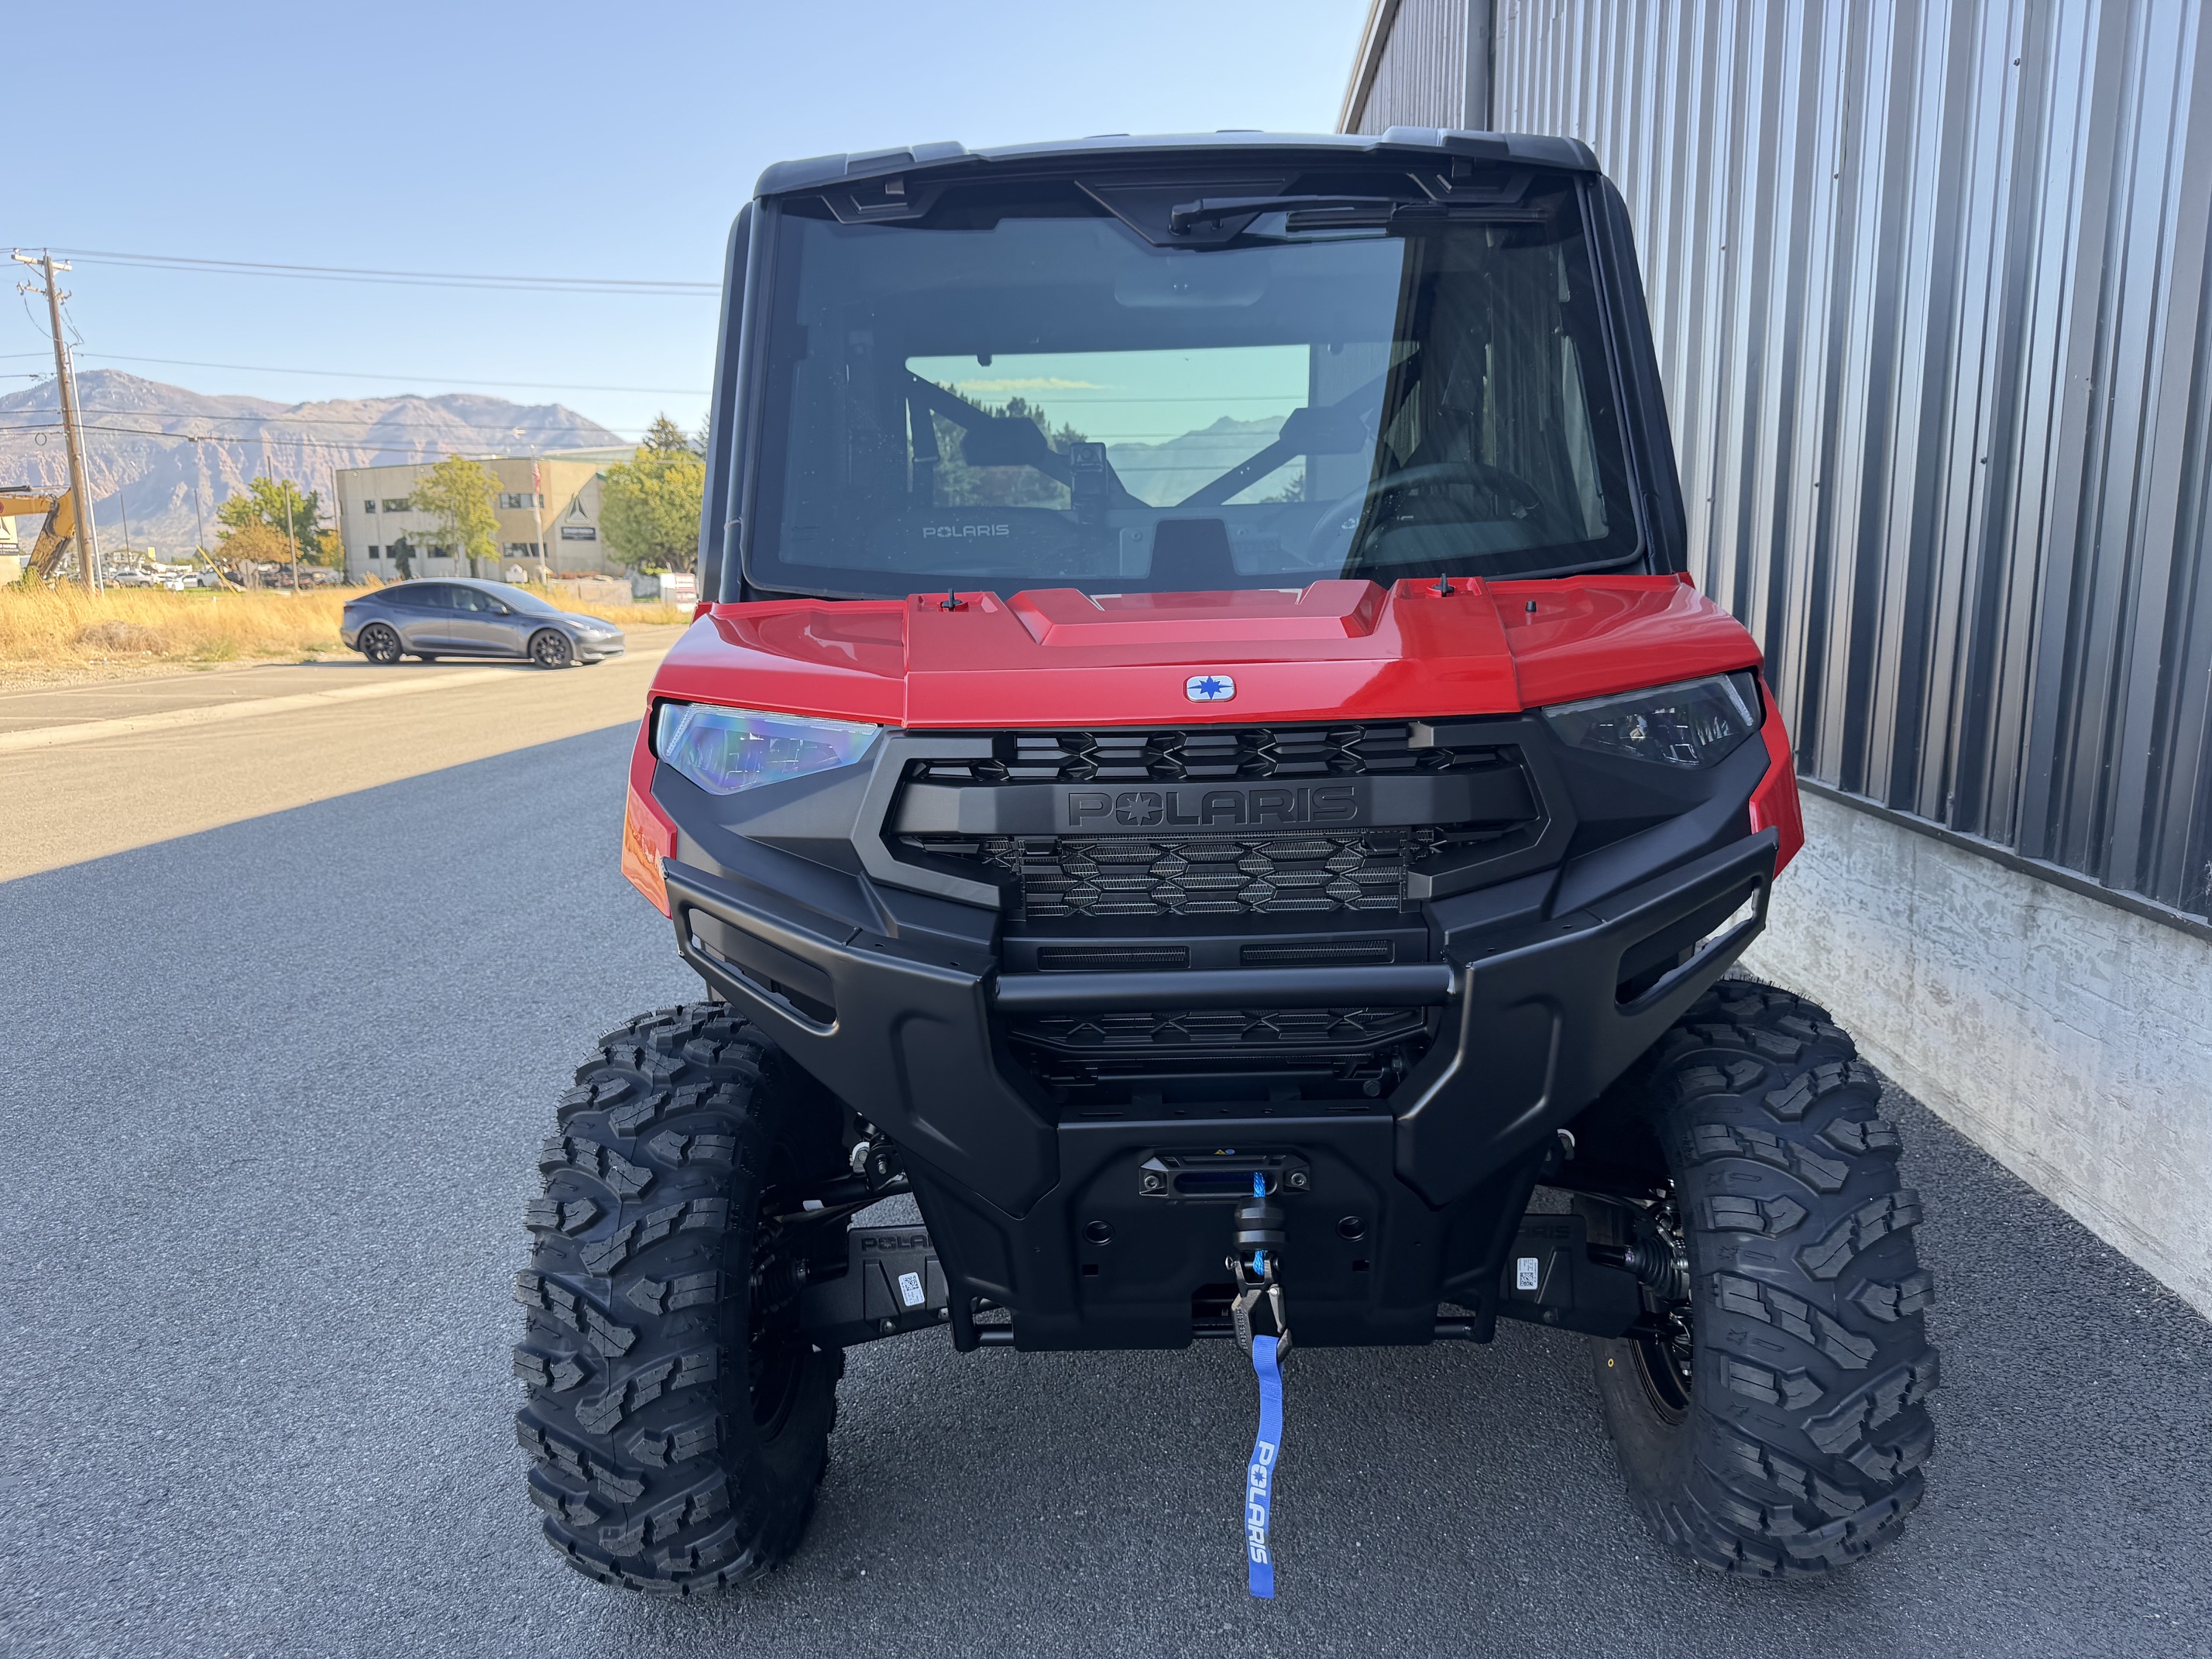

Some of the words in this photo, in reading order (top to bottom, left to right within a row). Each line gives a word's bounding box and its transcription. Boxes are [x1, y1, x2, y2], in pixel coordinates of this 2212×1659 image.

[923, 524, 1010, 538] POLARIS
[1068, 785, 1358, 827] POLARIS
[860, 1233, 935, 1252] POLA
[1248, 1440, 1276, 1565] POLARIS
